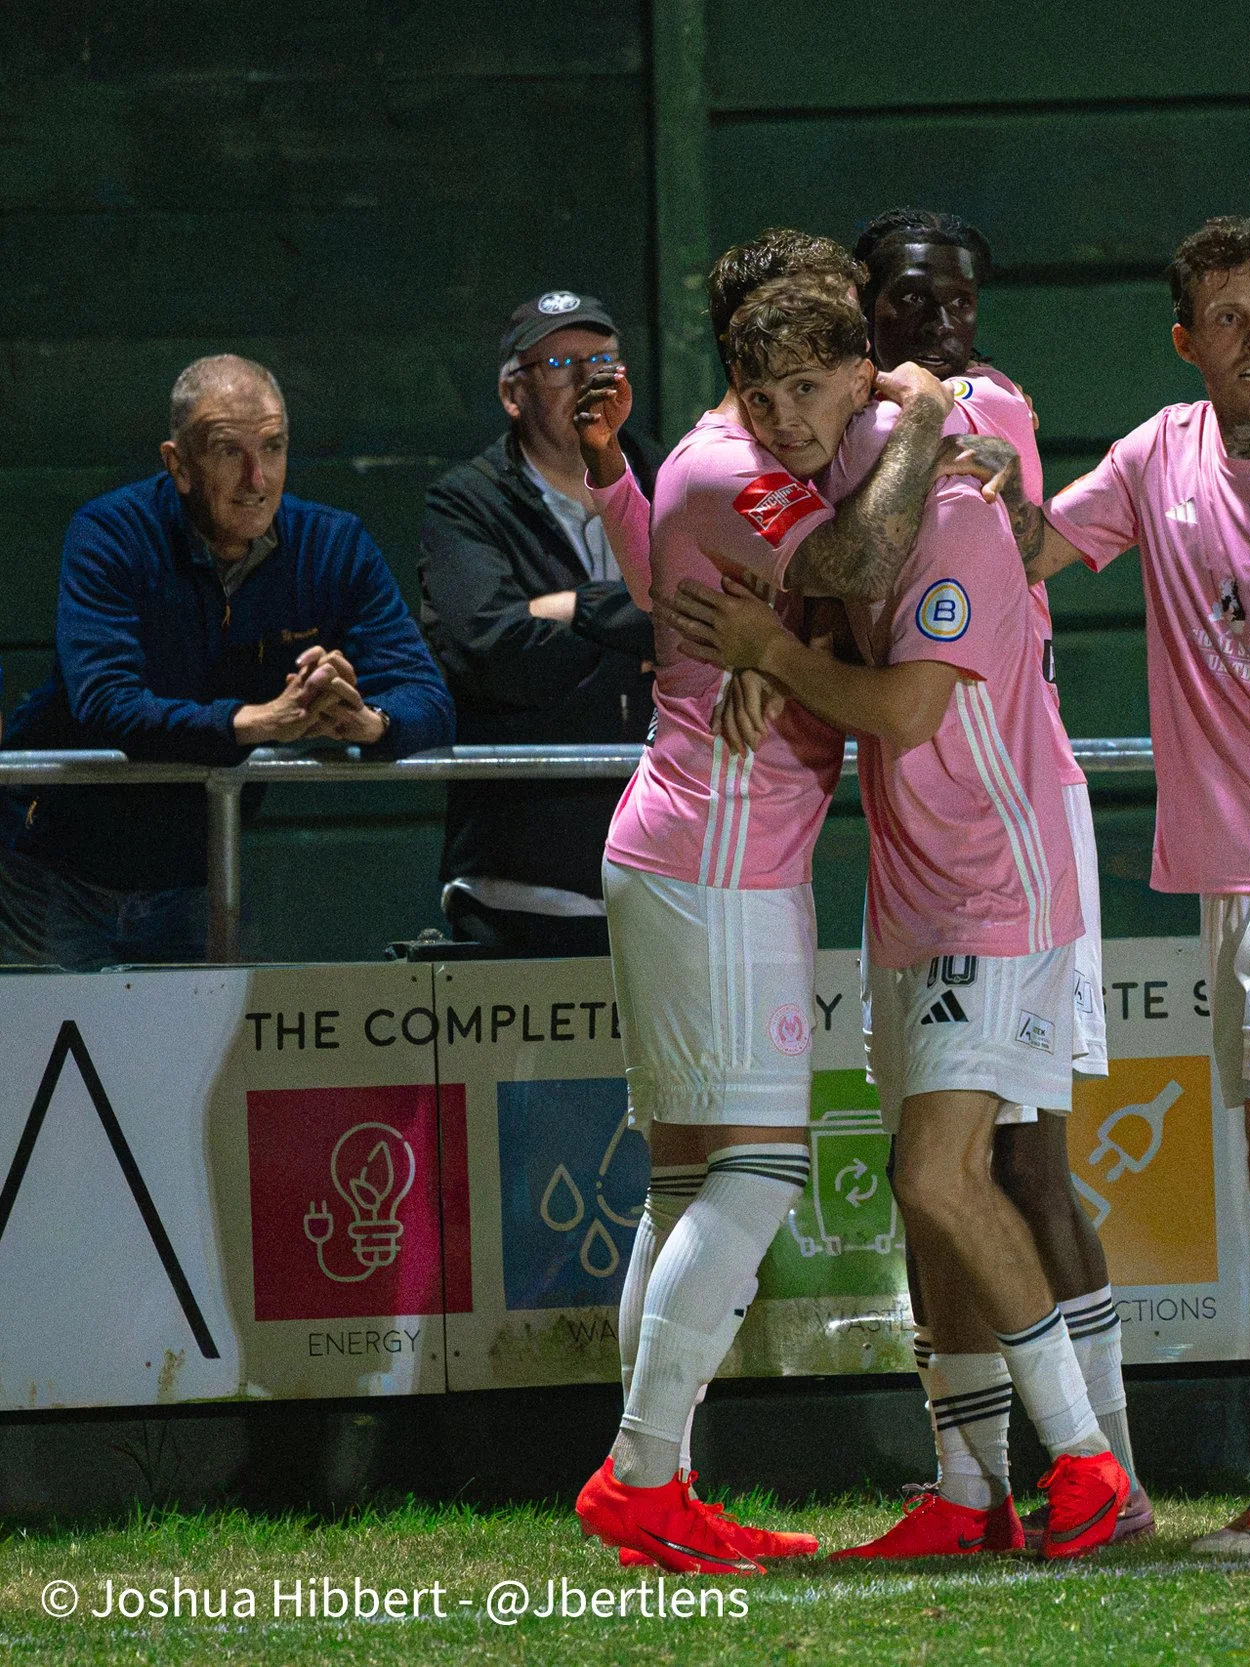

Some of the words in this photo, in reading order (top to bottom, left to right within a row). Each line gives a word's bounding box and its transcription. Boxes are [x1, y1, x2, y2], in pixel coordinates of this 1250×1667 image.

[933, 600, 956, 621] B
[245, 1010, 341, 1052] THE
[307, 1329, 422, 1357] ENERGY
